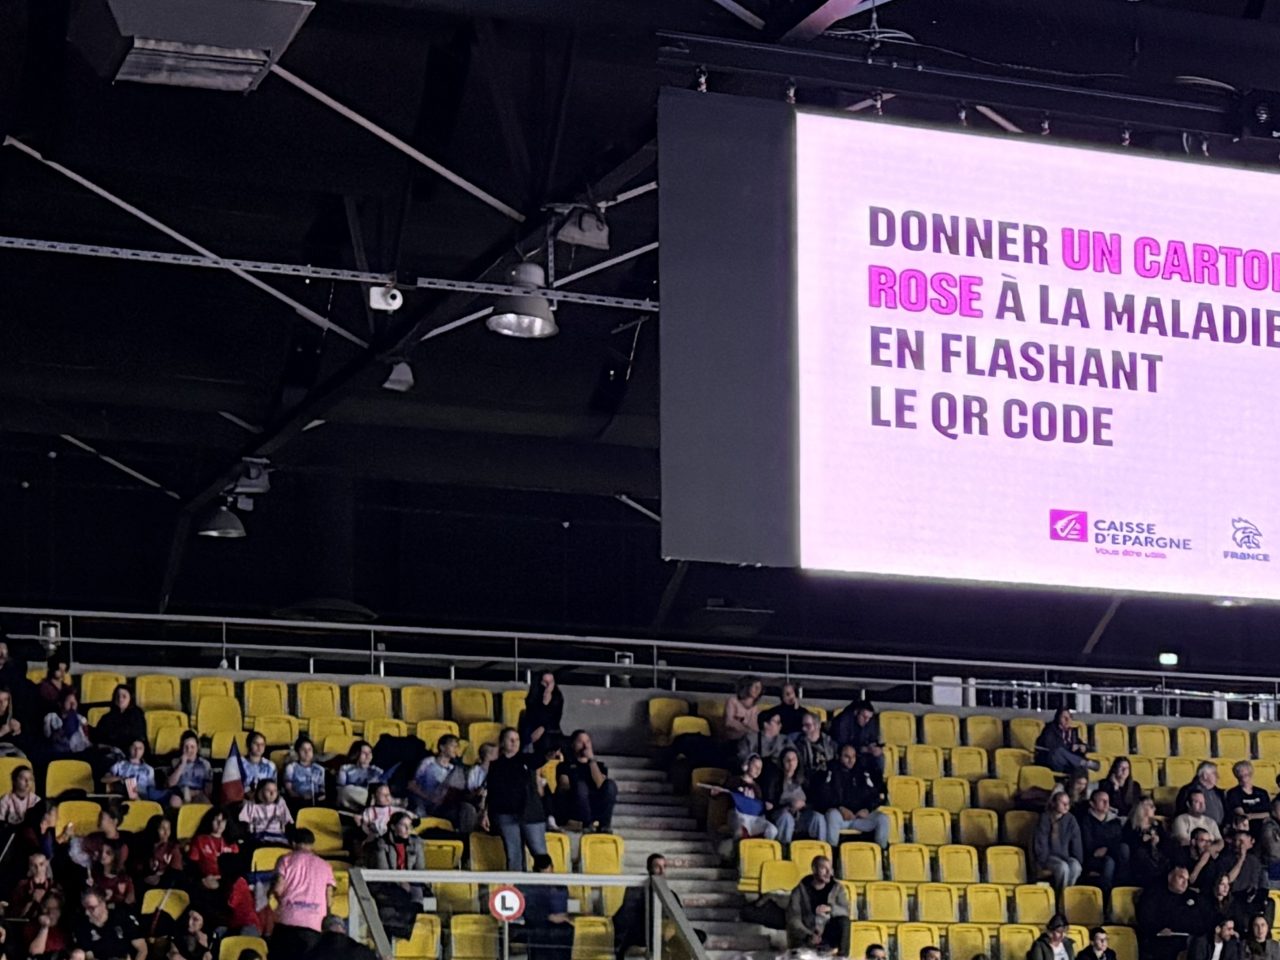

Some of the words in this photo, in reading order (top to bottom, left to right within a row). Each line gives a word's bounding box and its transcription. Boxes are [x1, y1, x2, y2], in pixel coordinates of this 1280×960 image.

[869, 205, 1048, 265] DONNER
[1061, 227, 1122, 275] UN
[868, 264, 984, 319] ROSE
[995, 272, 1026, 322] À
[1039, 284, 1090, 329] LA
[870, 326, 925, 370] EN
[941, 332, 1164, 393] FLASHANT
[870, 385, 917, 429] LE
[931, 391, 989, 440] QR
[1003, 398, 1114, 447] CODE
[1094, 519, 1156, 535] CAISSE
[1223, 550, 1271, 562] FRANCE
[500, 894, 515, 911] L
